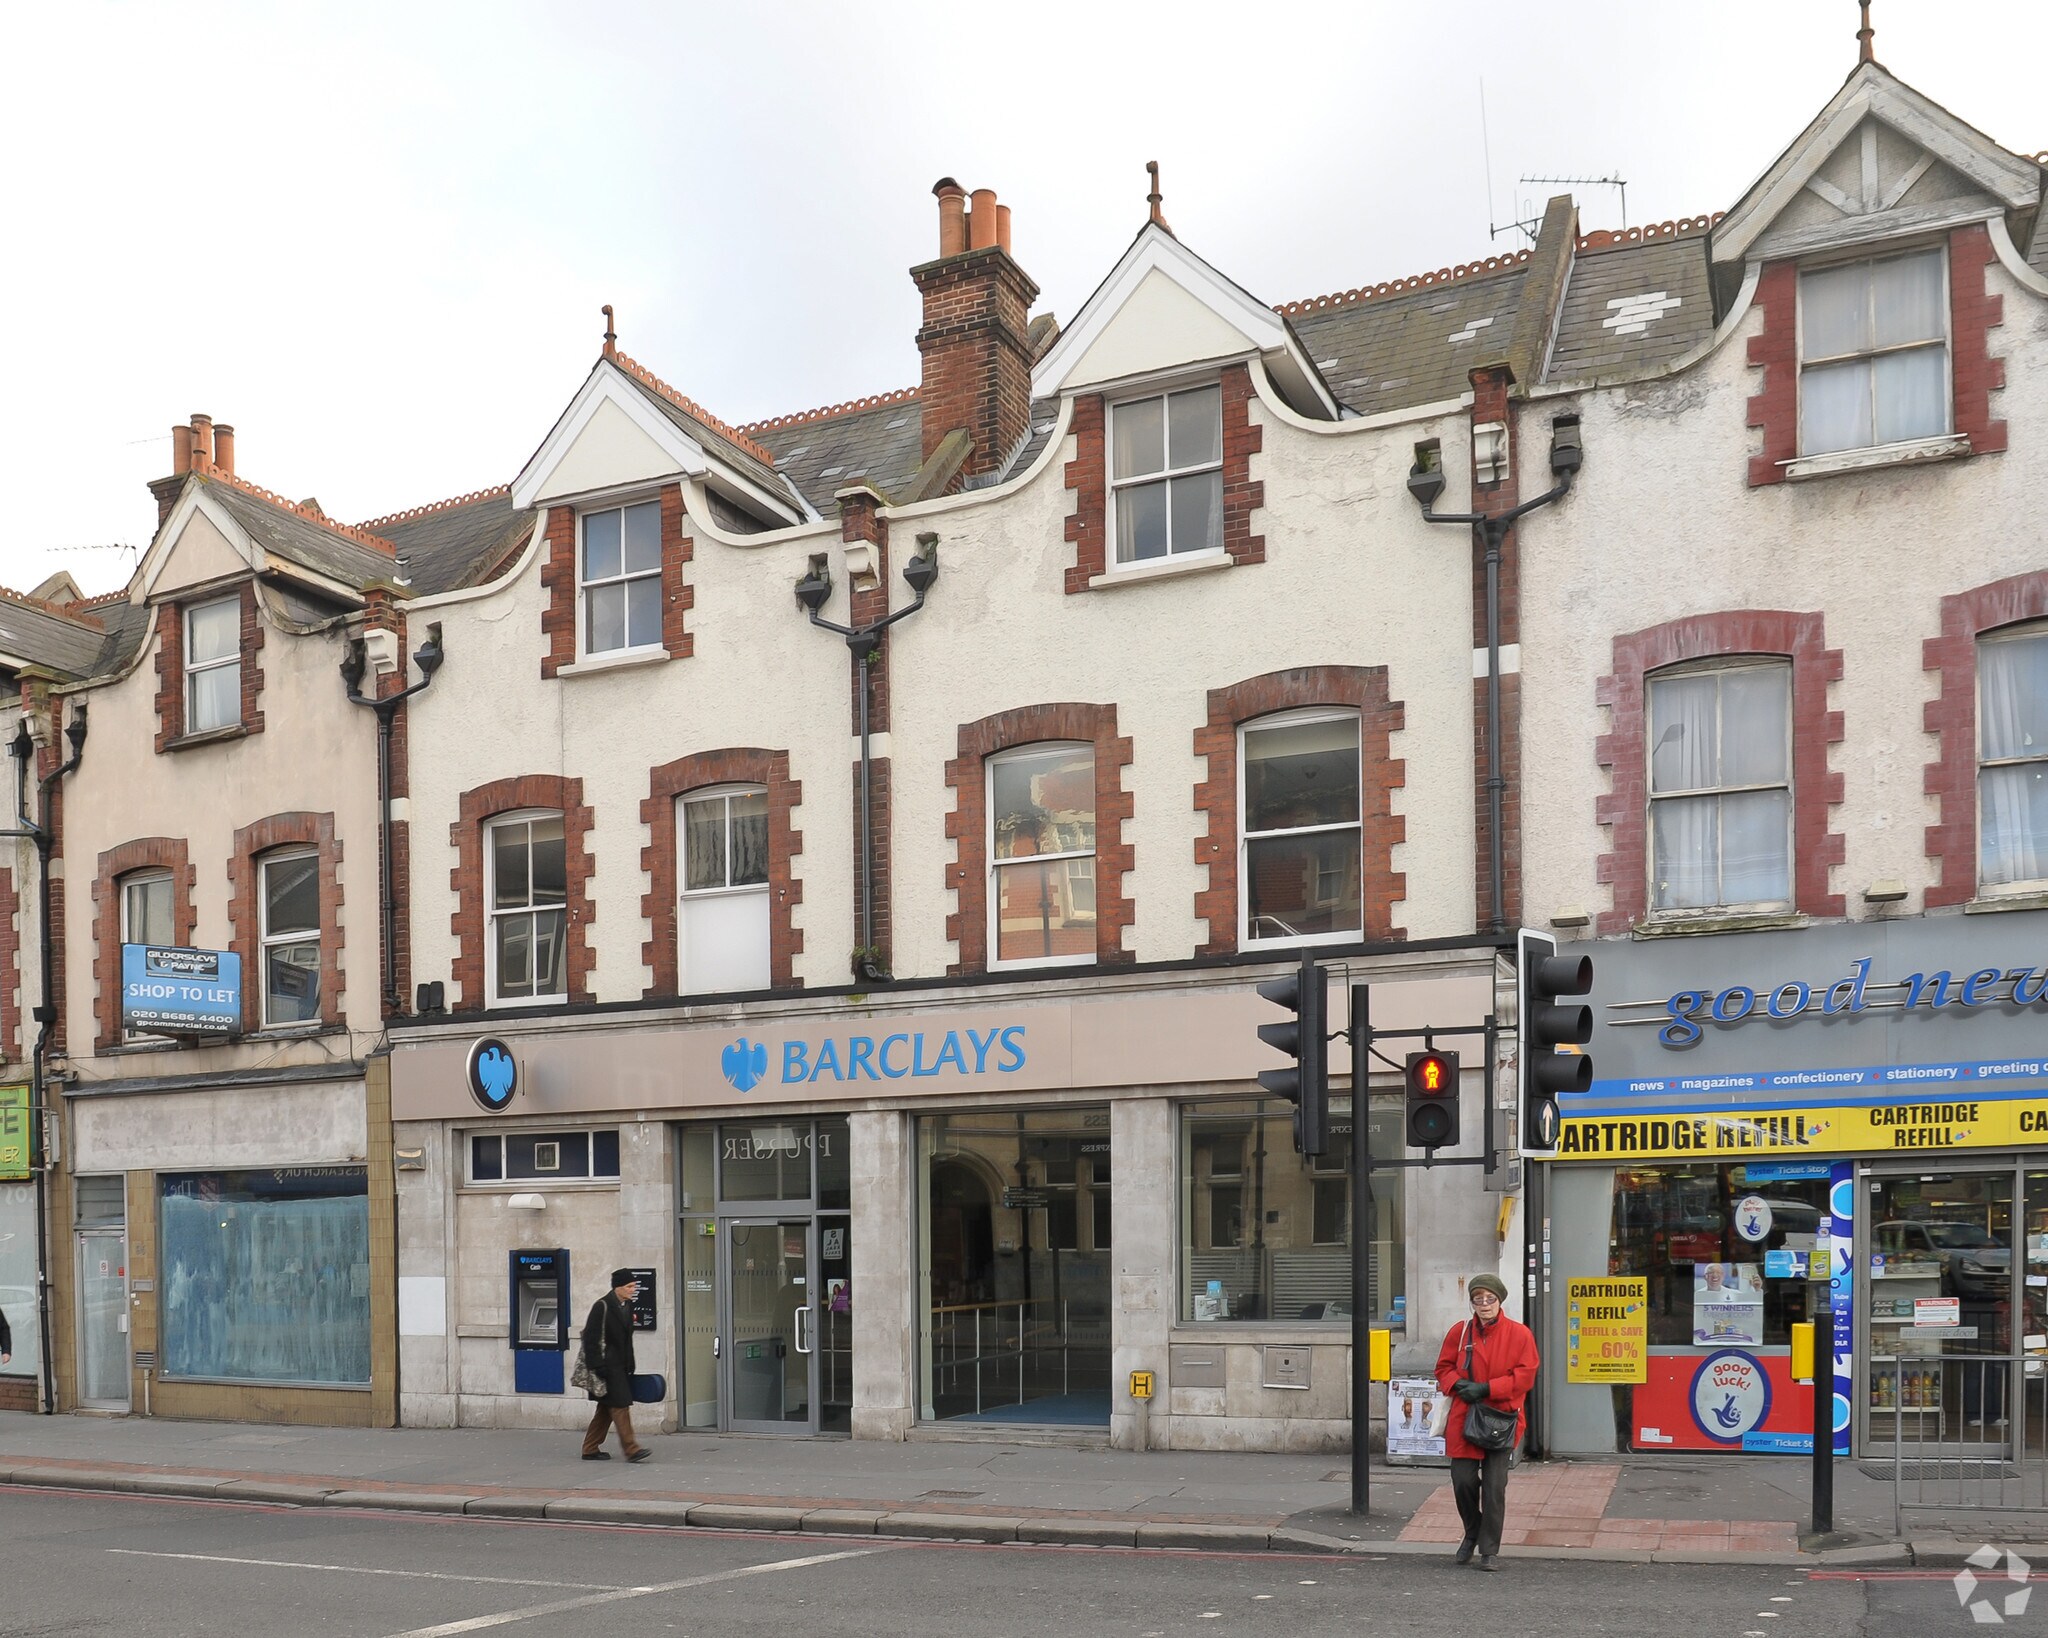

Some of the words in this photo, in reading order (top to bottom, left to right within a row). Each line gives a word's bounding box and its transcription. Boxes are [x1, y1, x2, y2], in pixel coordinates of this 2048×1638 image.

[147, 951, 217, 962] GILDERSLEVE
[171, 962, 205, 971] PAYNE
[129, 983, 176, 998] SHOP
[180, 987, 203, 1001] TO
[208, 989, 235, 1003] LET
[1658, 956, 1872, 1048] good
[131, 1010, 158, 1019] 020
[161, 1012, 195, 1021] 8686
[199, 1015, 233, 1023] 4400
[136, 1020, 228, 1031] gpcommercial.co.uk
[781, 1026, 1026, 1083] BARCLAYS
[1630, 1080, 1664, 1091] news
[1681, 1075, 1754, 1091] magazines
[1773, 1070, 1864, 1086] confectionery
[1886, 1067, 1958, 1080] stationery
[1978, 1062, 2039, 1077] greeting
[1870, 1103, 1979, 1126] CARTRIDGE
[2020, 1111, 2048, 1132] CA
[1557, 1119, 1707, 1153] ARTRIDGE
[1715, 1115, 1809, 1148] REFILL
[1894, 1127, 1953, 1147] REFILL
[1749, 1167, 1775, 1176] oyster
[1778, 1166, 1805, 1174] Ticket
[1807, 1165, 1828, 1174] Stop
[1571, 1284, 1643, 1298] CARTRIDGE
[1588, 1307, 1627, 1319] REFILL
[1582, 1327, 1609, 1336] REFILL
[1621, 1327, 1643, 1336] SAVE
[1952, 1328, 1976, 1338] door
[1602, 1341, 1638, 1358] 60%
[1714, 1364, 1752, 1377] good
[1133, 1375, 1149, 1395] H
[1745, 1439, 1772, 1447] oyster
[1775, 1439, 1801, 1447] Ticket
